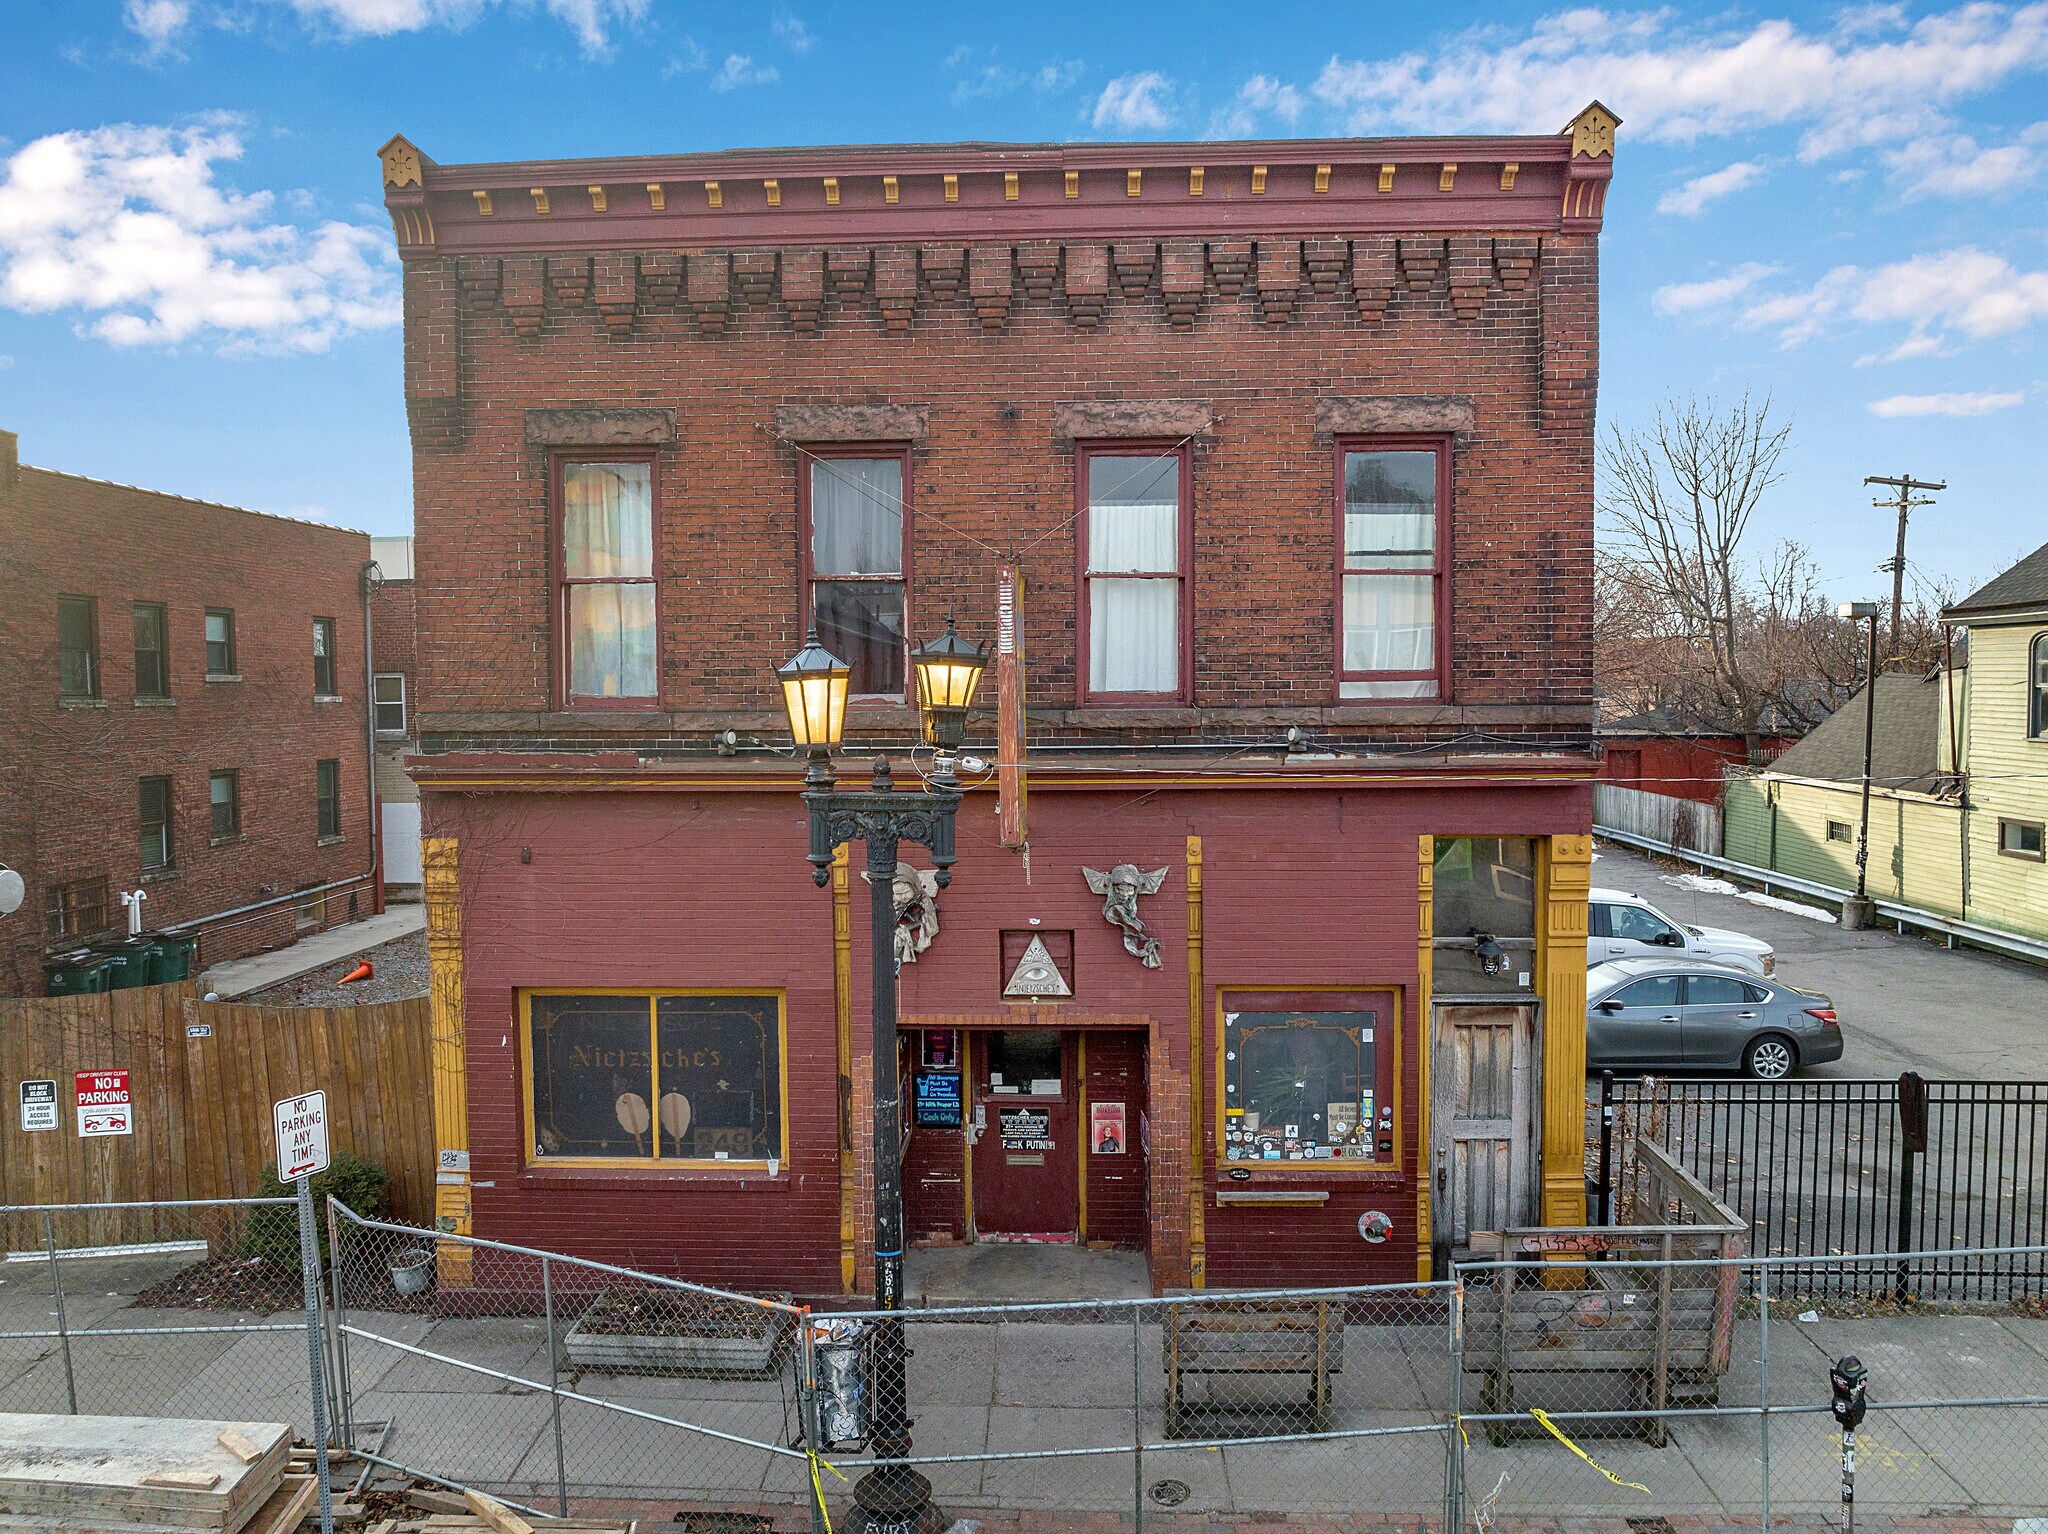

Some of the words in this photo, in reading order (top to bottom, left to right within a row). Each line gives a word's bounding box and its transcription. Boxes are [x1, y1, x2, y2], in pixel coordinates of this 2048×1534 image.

[95, 1077, 112, 1090] NO
[78, 1090, 129, 1105] PARKING
[293, 1099, 308, 1114] NO
[281, 1110, 322, 1135] PARKING
[923, 1112, 939, 1121] Cash
[940, 1112, 955, 1123] Only
[294, 1129, 312, 1147] ANY
